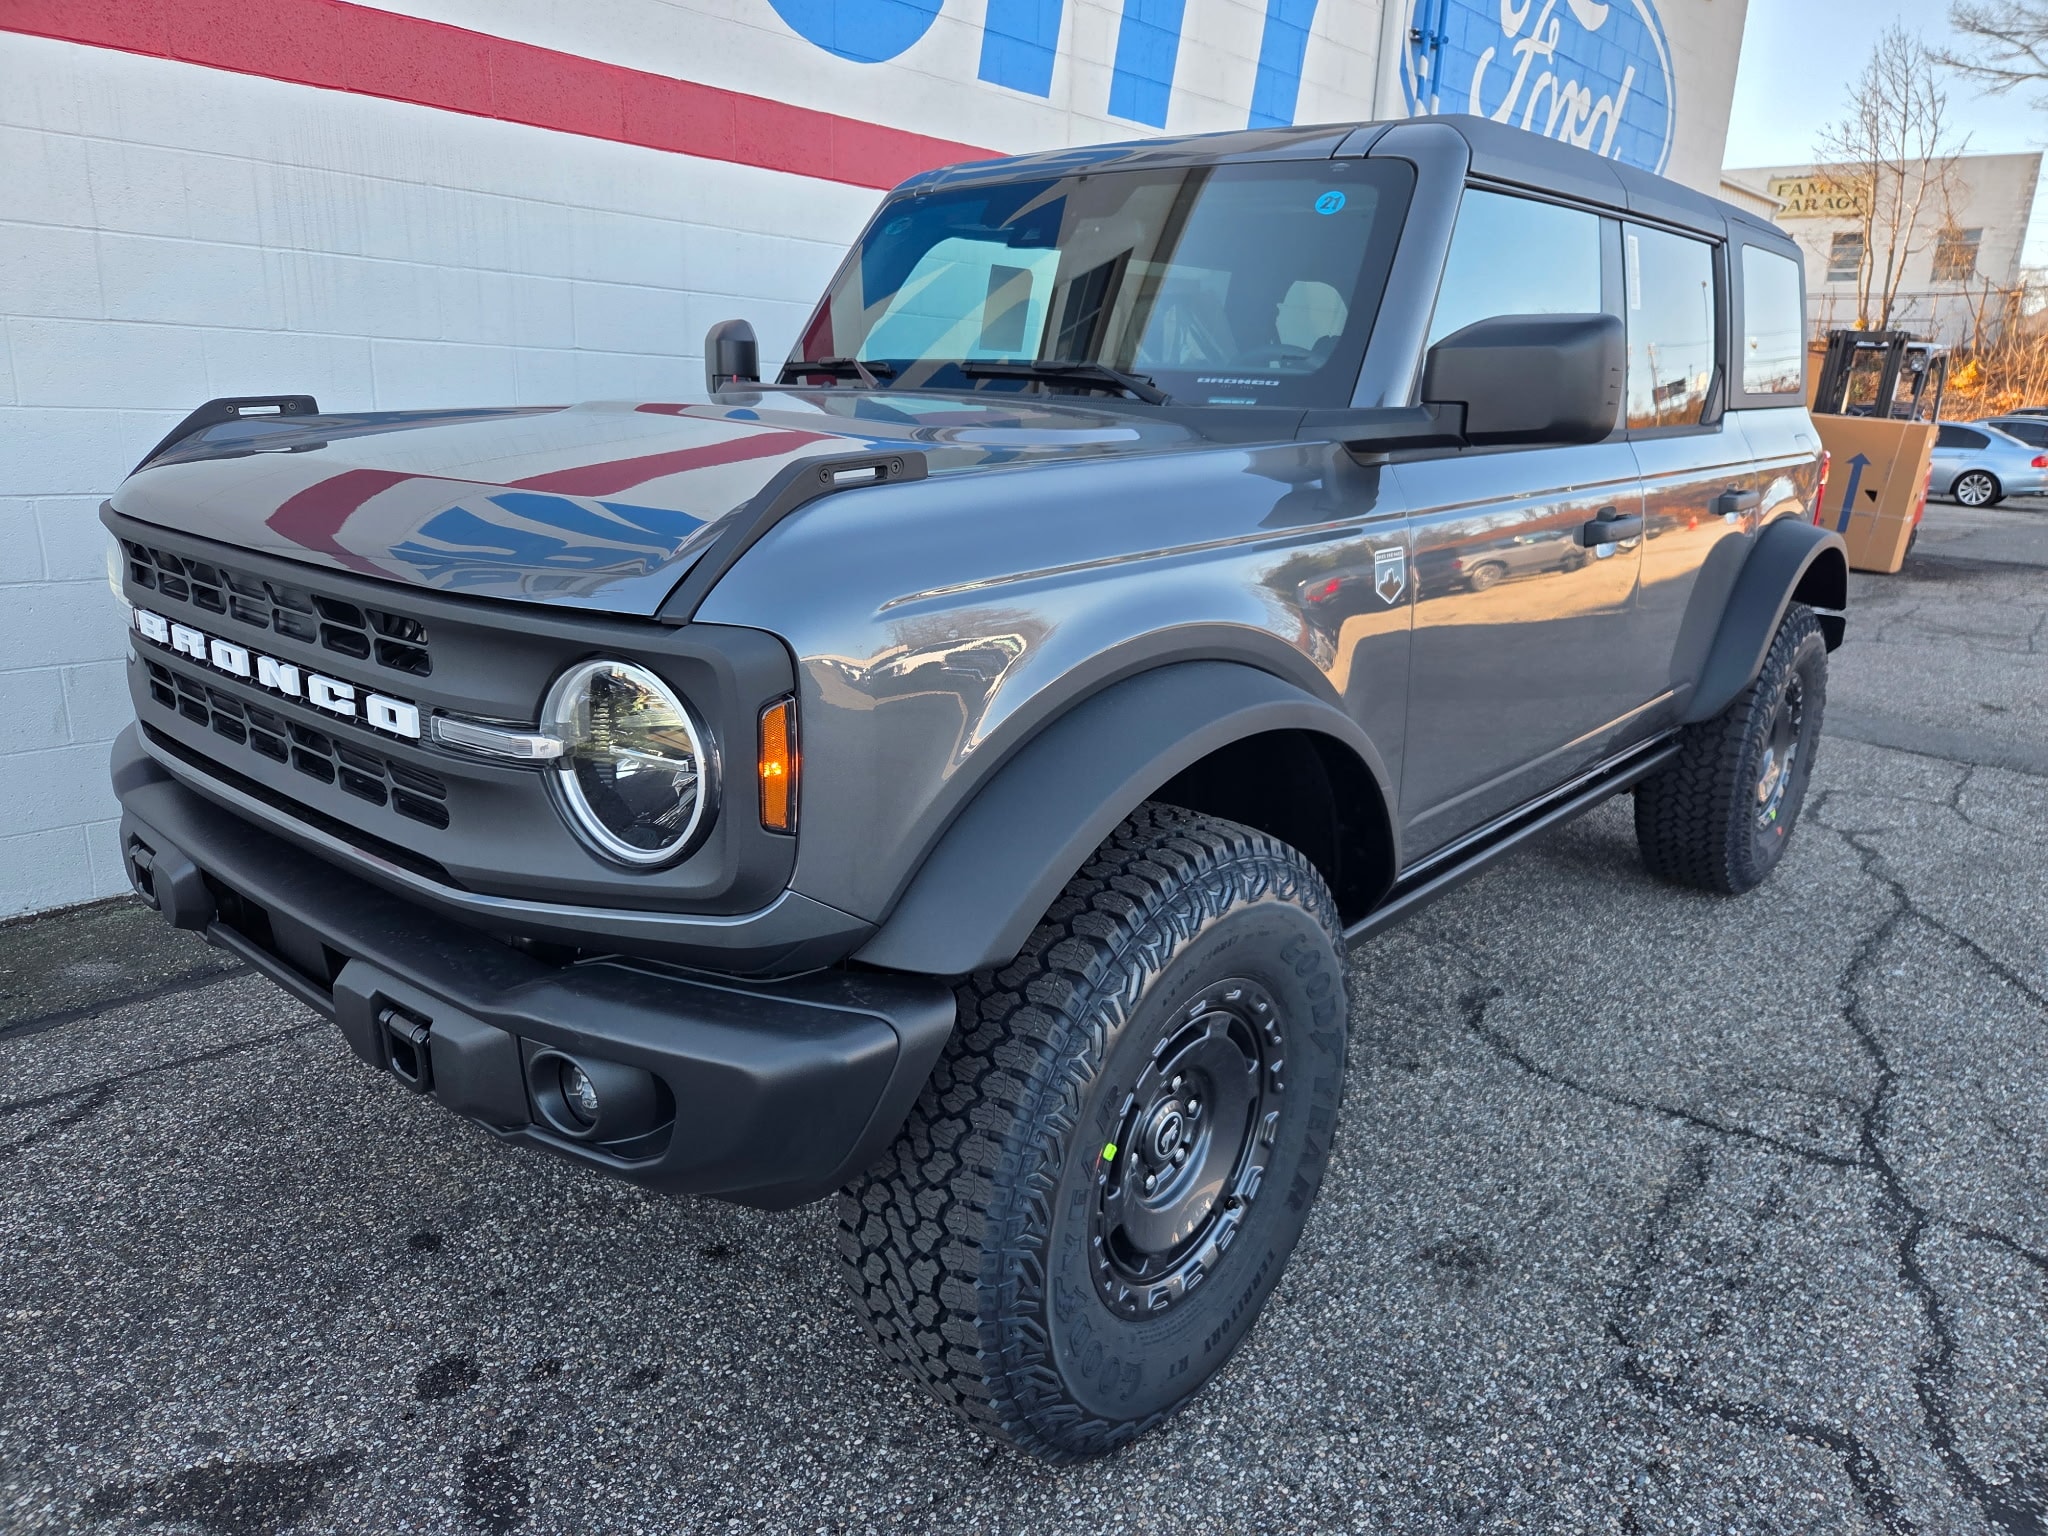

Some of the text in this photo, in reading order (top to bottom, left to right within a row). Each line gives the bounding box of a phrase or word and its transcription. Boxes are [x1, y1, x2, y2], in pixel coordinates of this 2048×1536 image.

[1468, 0, 1636, 161] Ford
[1319, 195, 1343, 210] 21
[138, 609, 421, 739] BRONCO
[1279, 932, 1344, 1212] GOODYEAR
[1203, 1247, 1276, 1355] TERRITORY
[1167, 1354, 1190, 1380] RT
